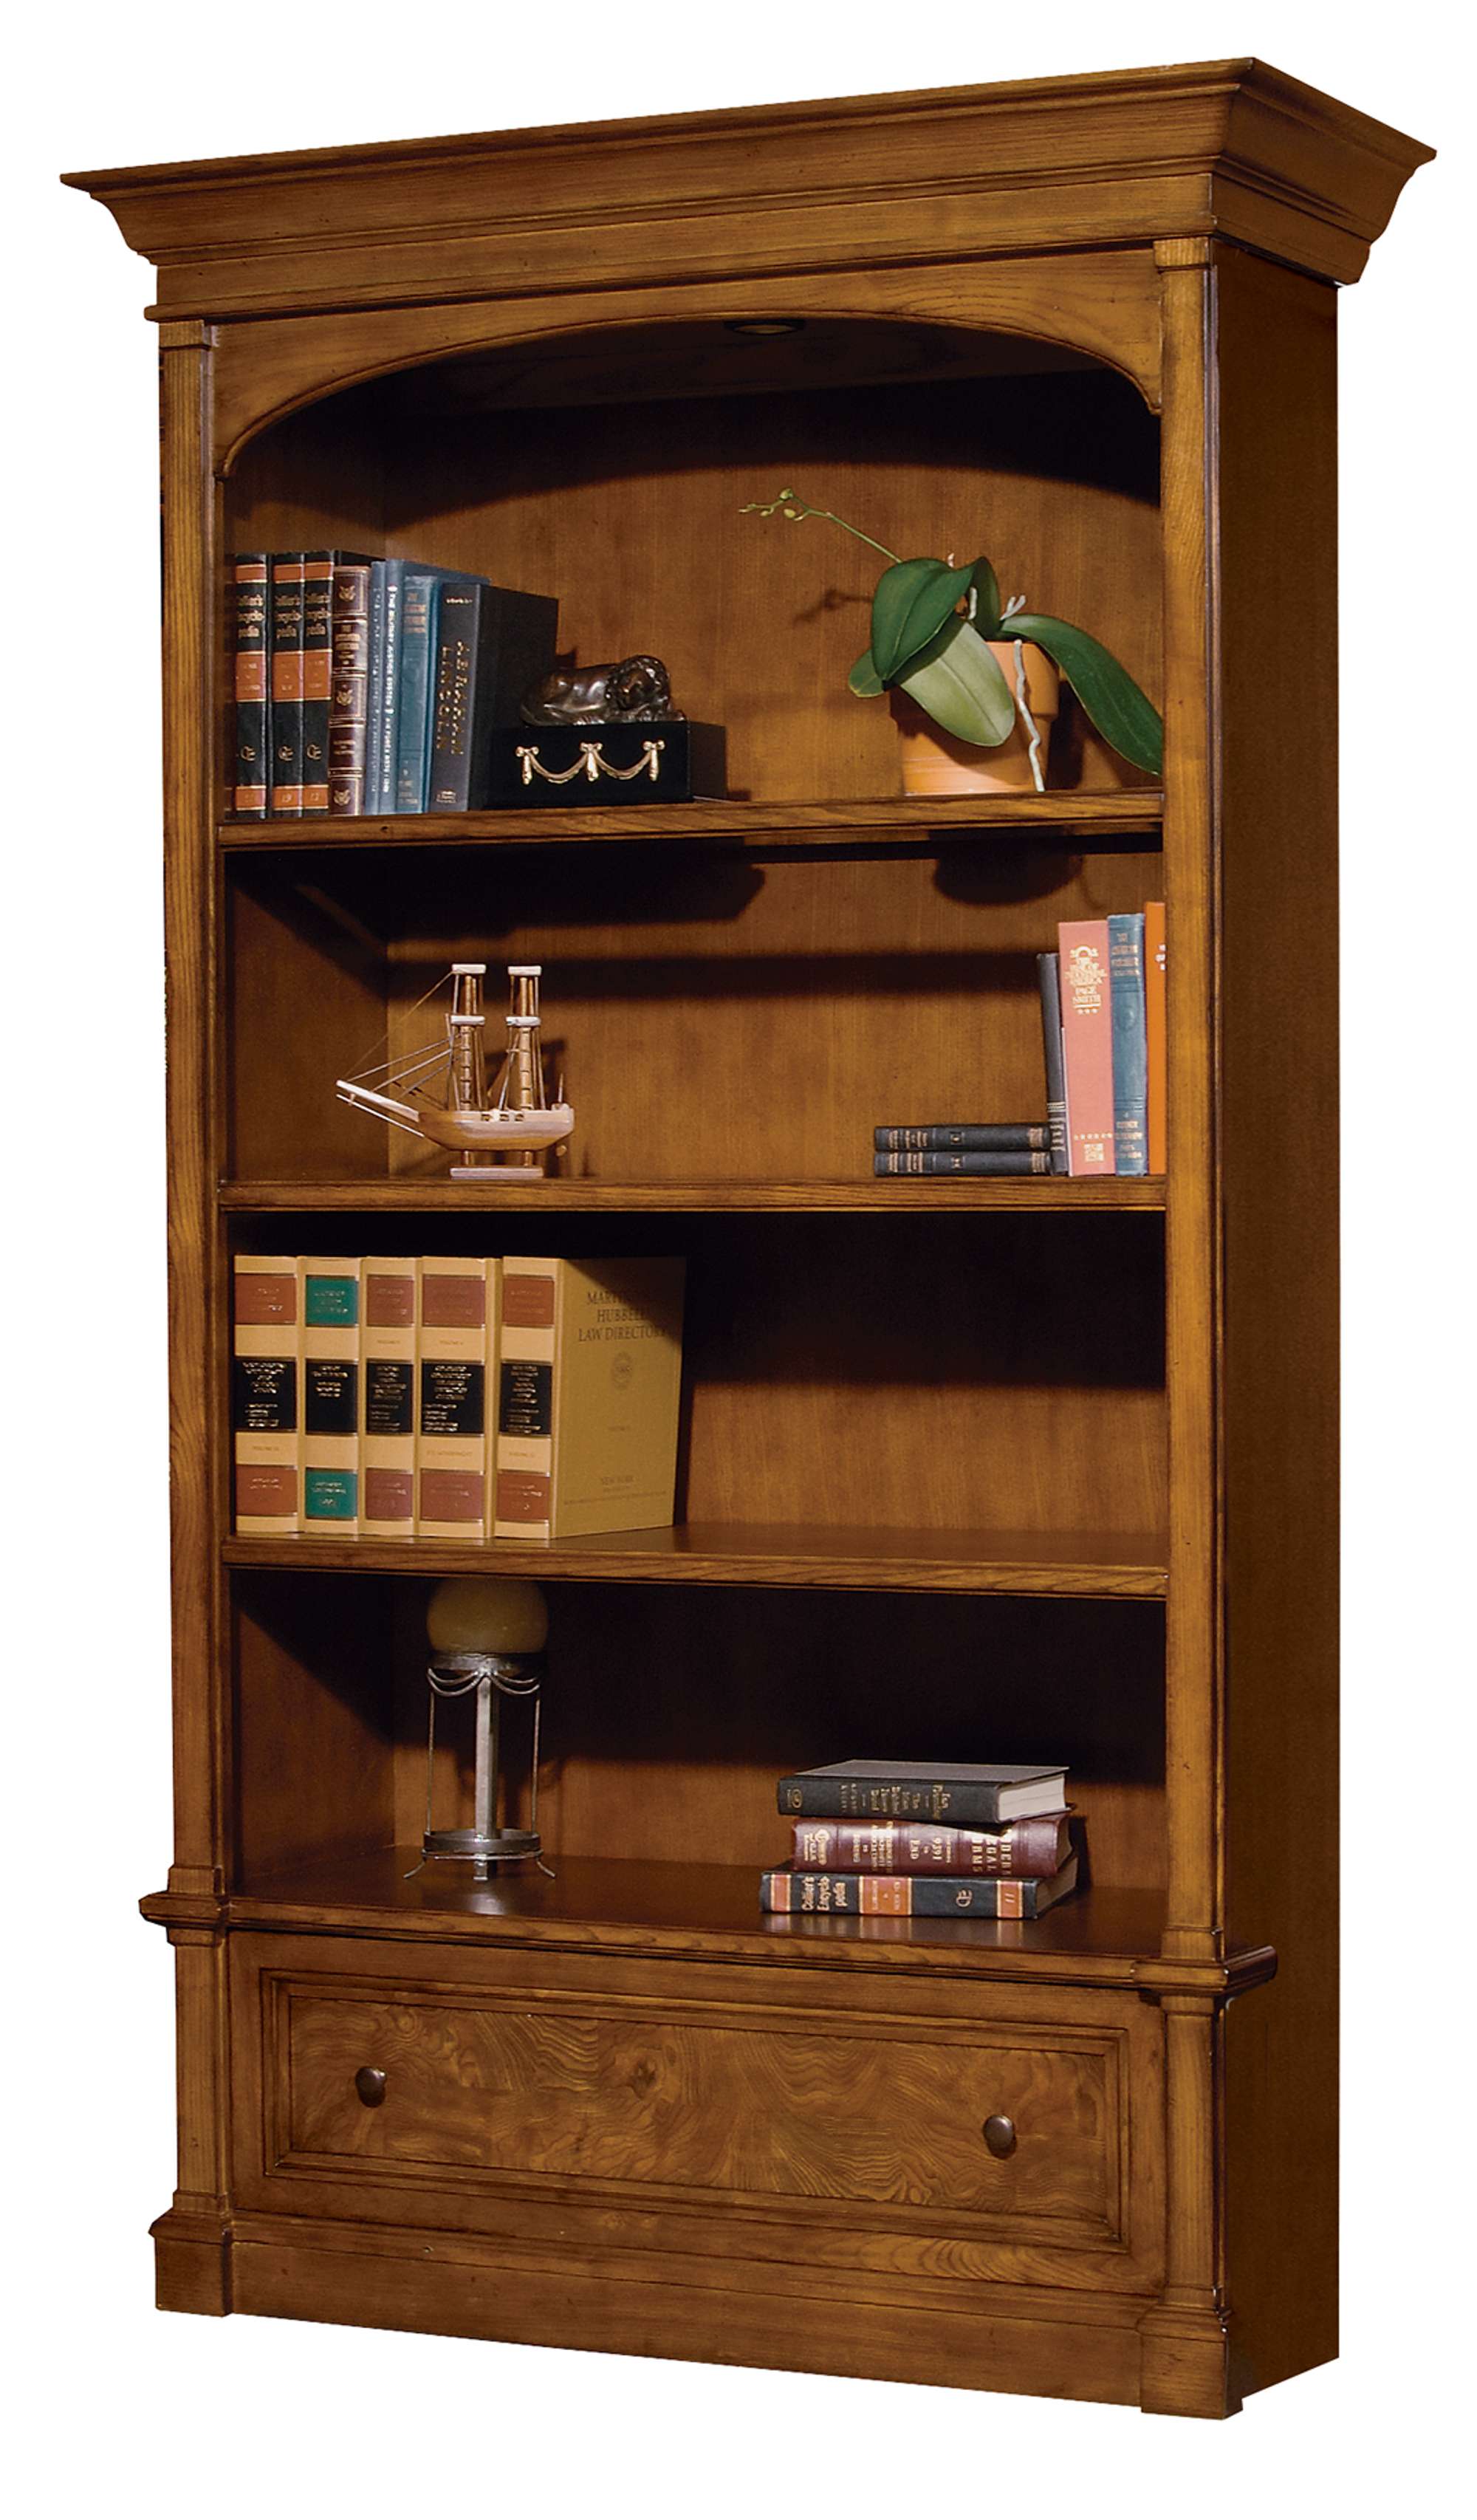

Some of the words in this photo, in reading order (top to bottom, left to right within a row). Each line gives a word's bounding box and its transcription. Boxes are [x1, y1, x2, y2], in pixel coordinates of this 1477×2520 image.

[436, 645, 453, 750] LINCOLN
[451, 641, 470, 755] ABRAHAM
[578, 1327, 601, 1342] LAW
[801, 1876, 815, 1911] Collier's
[817, 1875, 832, 1911] Encyclo-
[833, 1882, 848, 1907] pedia
